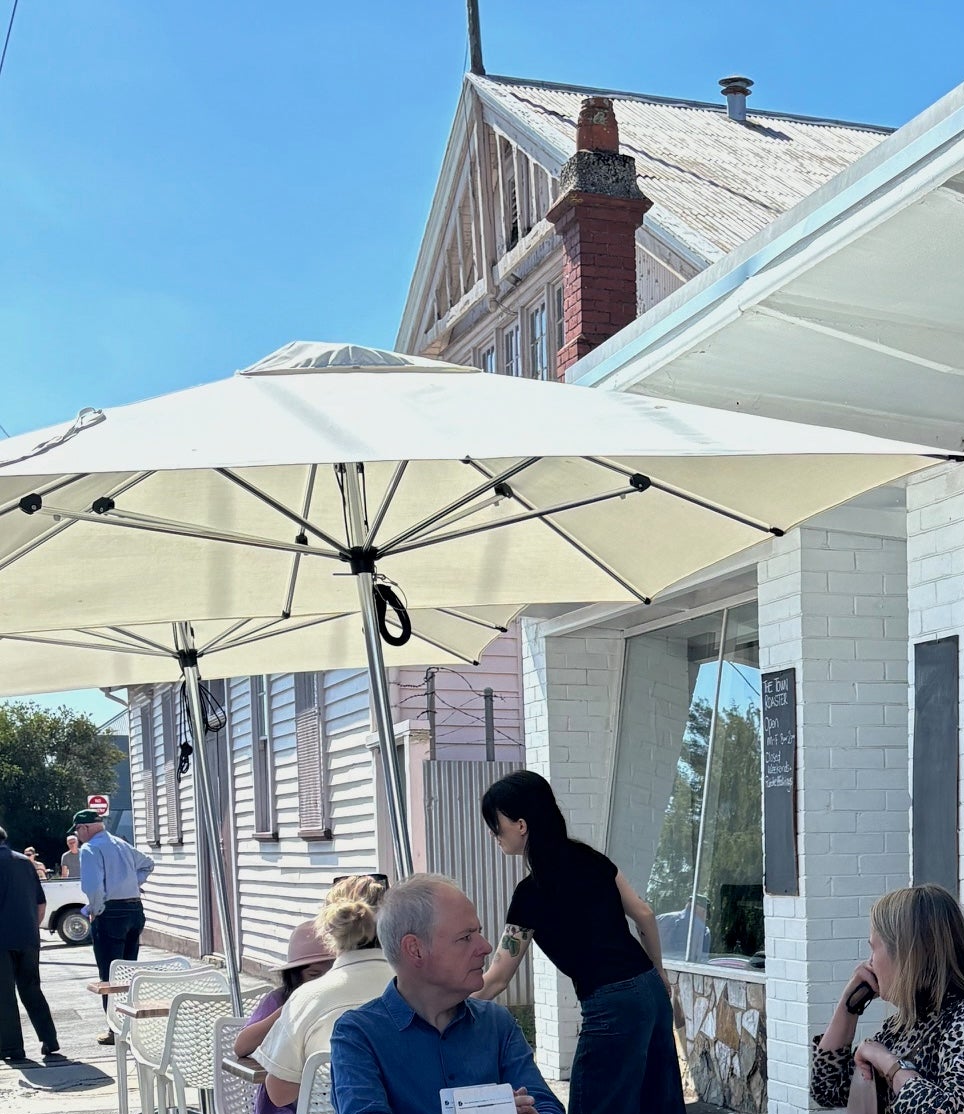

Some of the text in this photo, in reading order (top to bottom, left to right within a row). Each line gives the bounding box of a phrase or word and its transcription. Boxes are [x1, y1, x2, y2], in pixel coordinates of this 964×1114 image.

[774, 677, 789, 692] TOWN
[765, 692, 788, 711] ROASTER
[764, 717, 779, 736] Open
[765, 750, 781, 763] Closed
